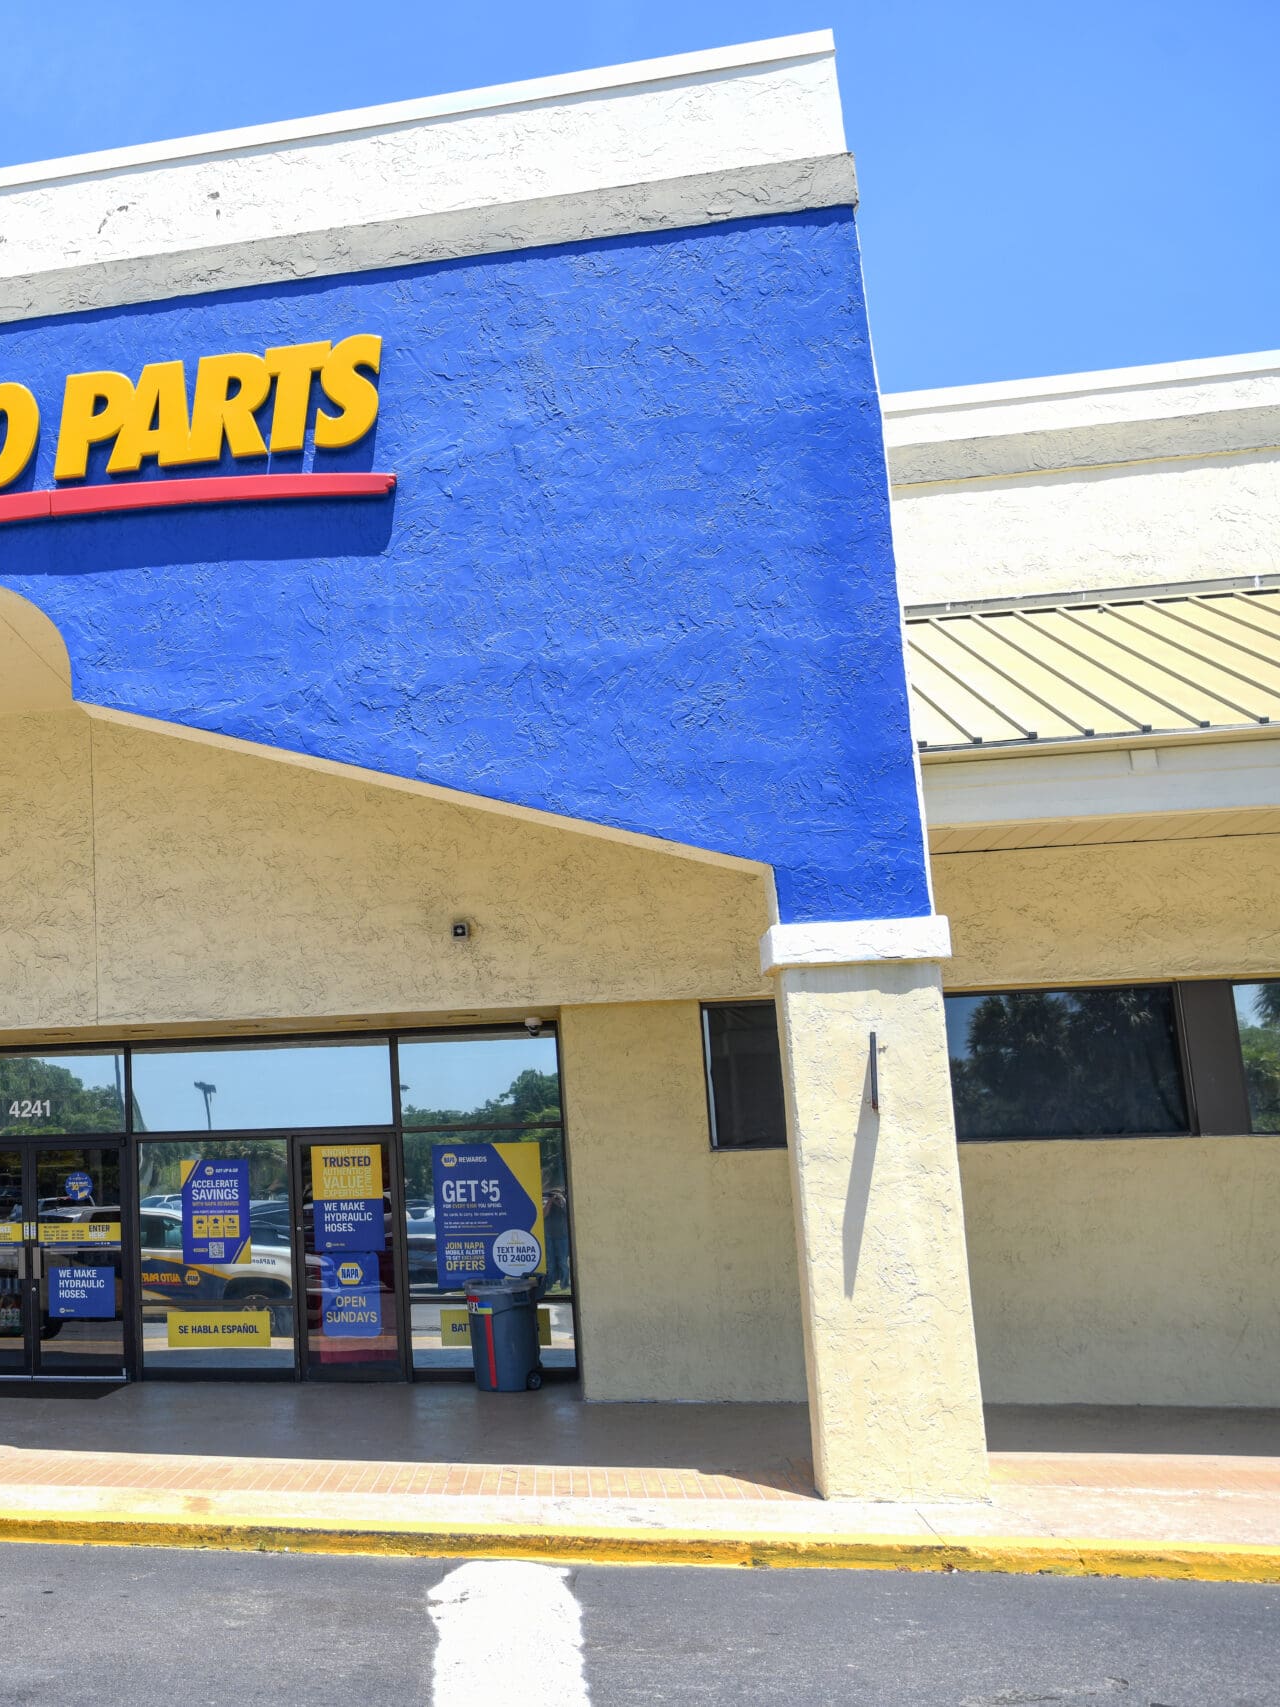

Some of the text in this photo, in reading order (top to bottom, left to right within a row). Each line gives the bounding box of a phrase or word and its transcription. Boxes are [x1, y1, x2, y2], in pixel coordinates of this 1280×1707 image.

[52, 333, 382, 481] PARTS
[9, 1100, 50, 1118] 4241
[322, 1156, 371, 1168] TRUSTED
[322, 1168, 364, 1176] AUTHENTIC
[192, 1180, 239, 1188] ACCELERATE
[322, 1176, 364, 1188] VALUE
[192, 1188, 240, 1200] SAVINGS
[442, 1178, 500, 1203] GET $5
[324, 1202, 366, 1211] WE MAKE
[324, 1212, 373, 1222] HYDRAULIC
[88, 1224, 110, 1232] ENTER
[324, 1222, 356, 1232] HOSES.
[445, 1242, 485, 1250] JOIN NAPA
[497, 1246, 536, 1254] TEXT NAPA
[497, 1254, 537, 1262] TO 24002
[446, 1260, 486, 1271] OFFERS
[58, 1269, 97, 1278] WE MAKE
[341, 1268, 359, 1279] NAPA
[58, 1279, 104, 1288] HYDRAULIC
[58, 1289, 88, 1298] HOSES.
[336, 1296, 366, 1308] OPEN
[326, 1311, 378, 1323] SUNDAYS
[178, 1322, 260, 1334] SE HABLA ESPAÑOL
